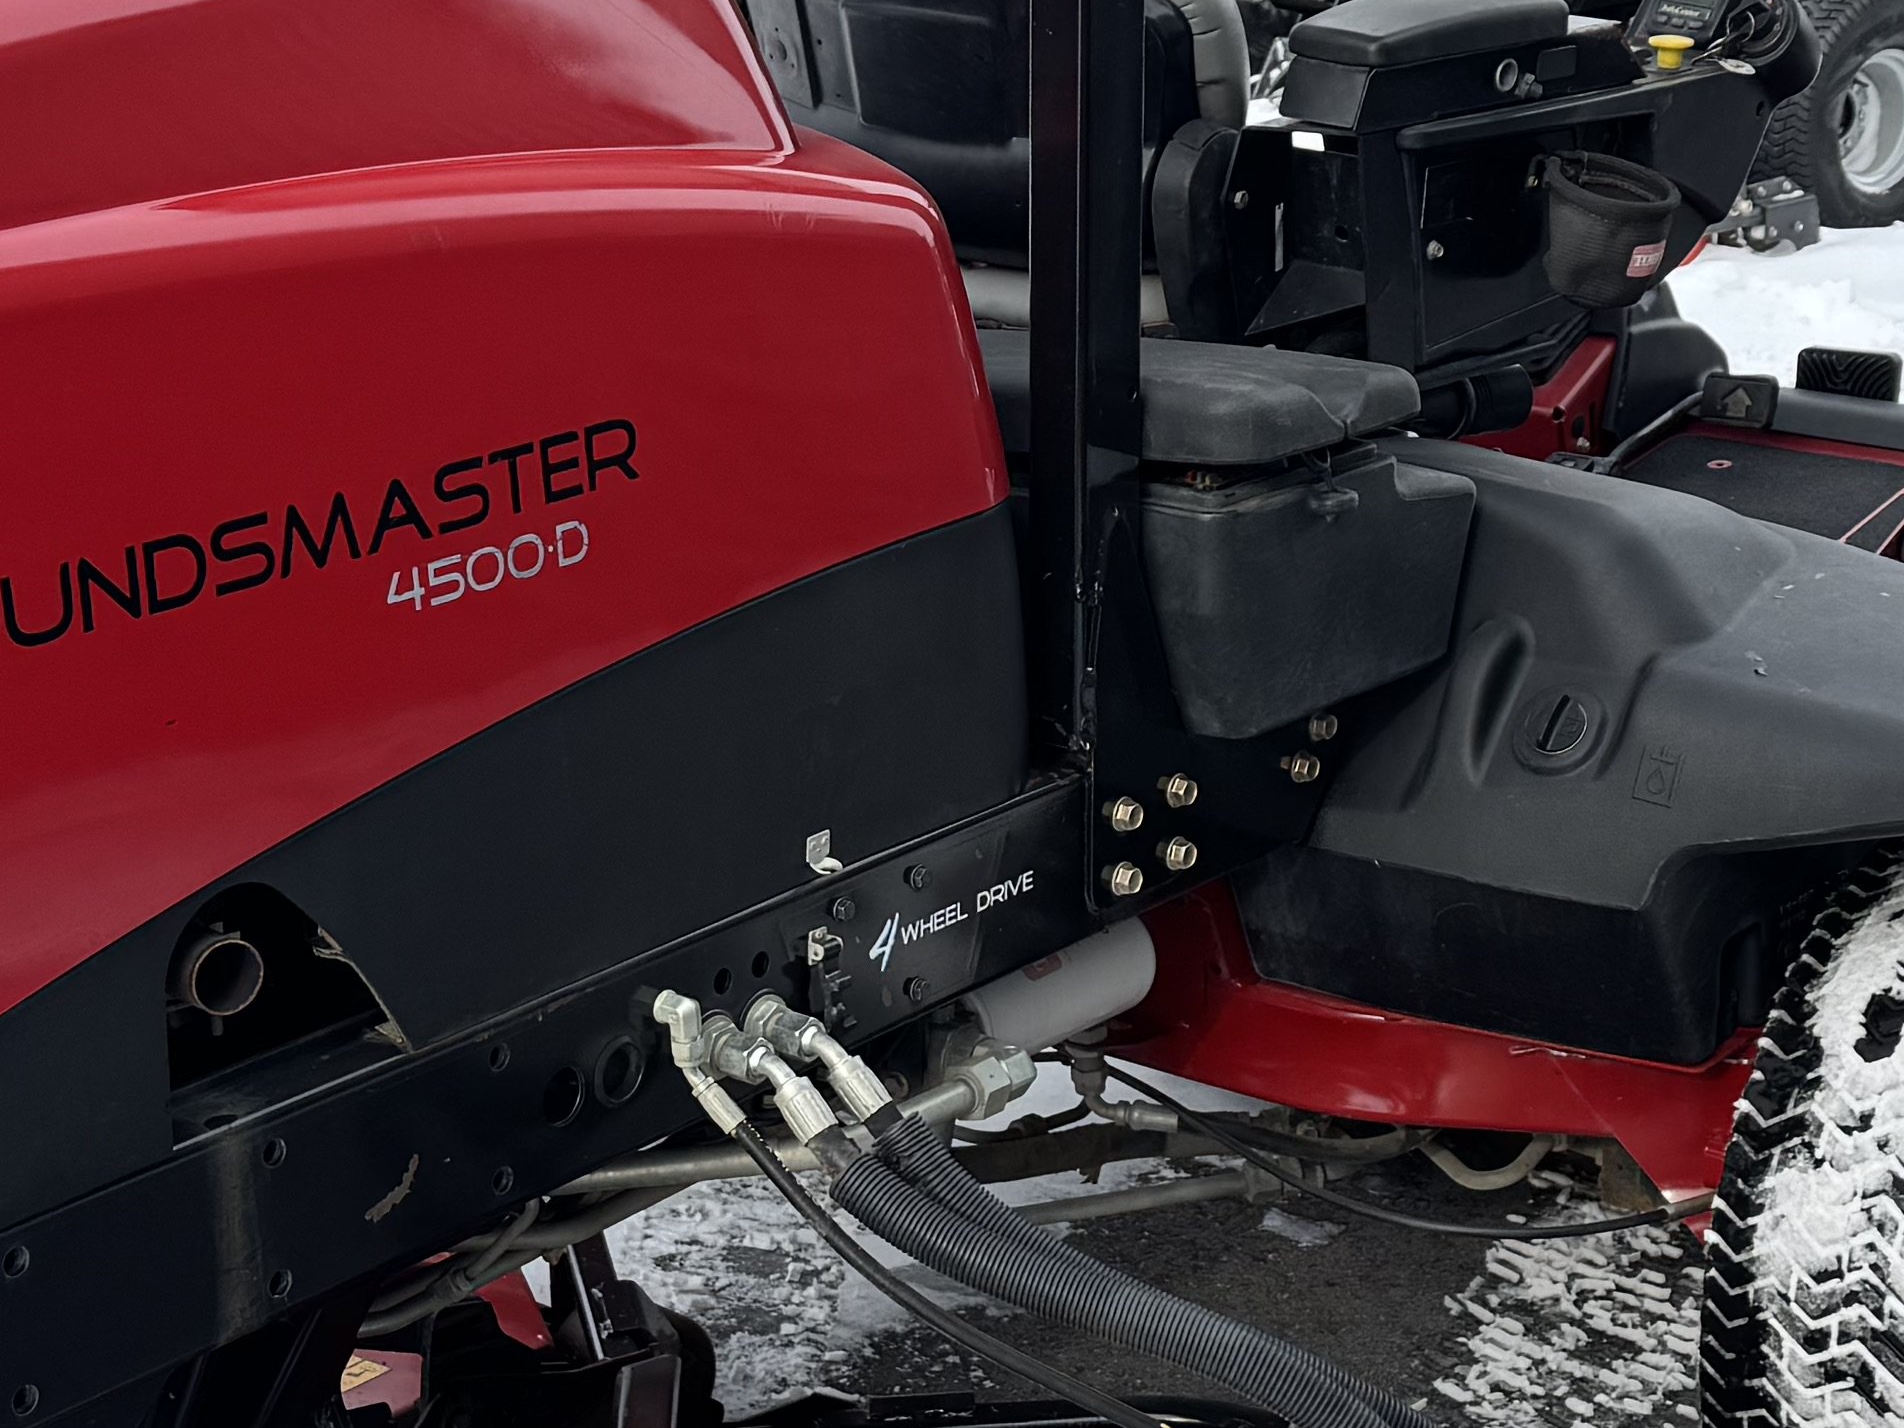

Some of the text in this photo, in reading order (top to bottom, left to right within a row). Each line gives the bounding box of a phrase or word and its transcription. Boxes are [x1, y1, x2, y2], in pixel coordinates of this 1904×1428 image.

[868, 870, 1034, 972] 4 WHEEL DRIVE
